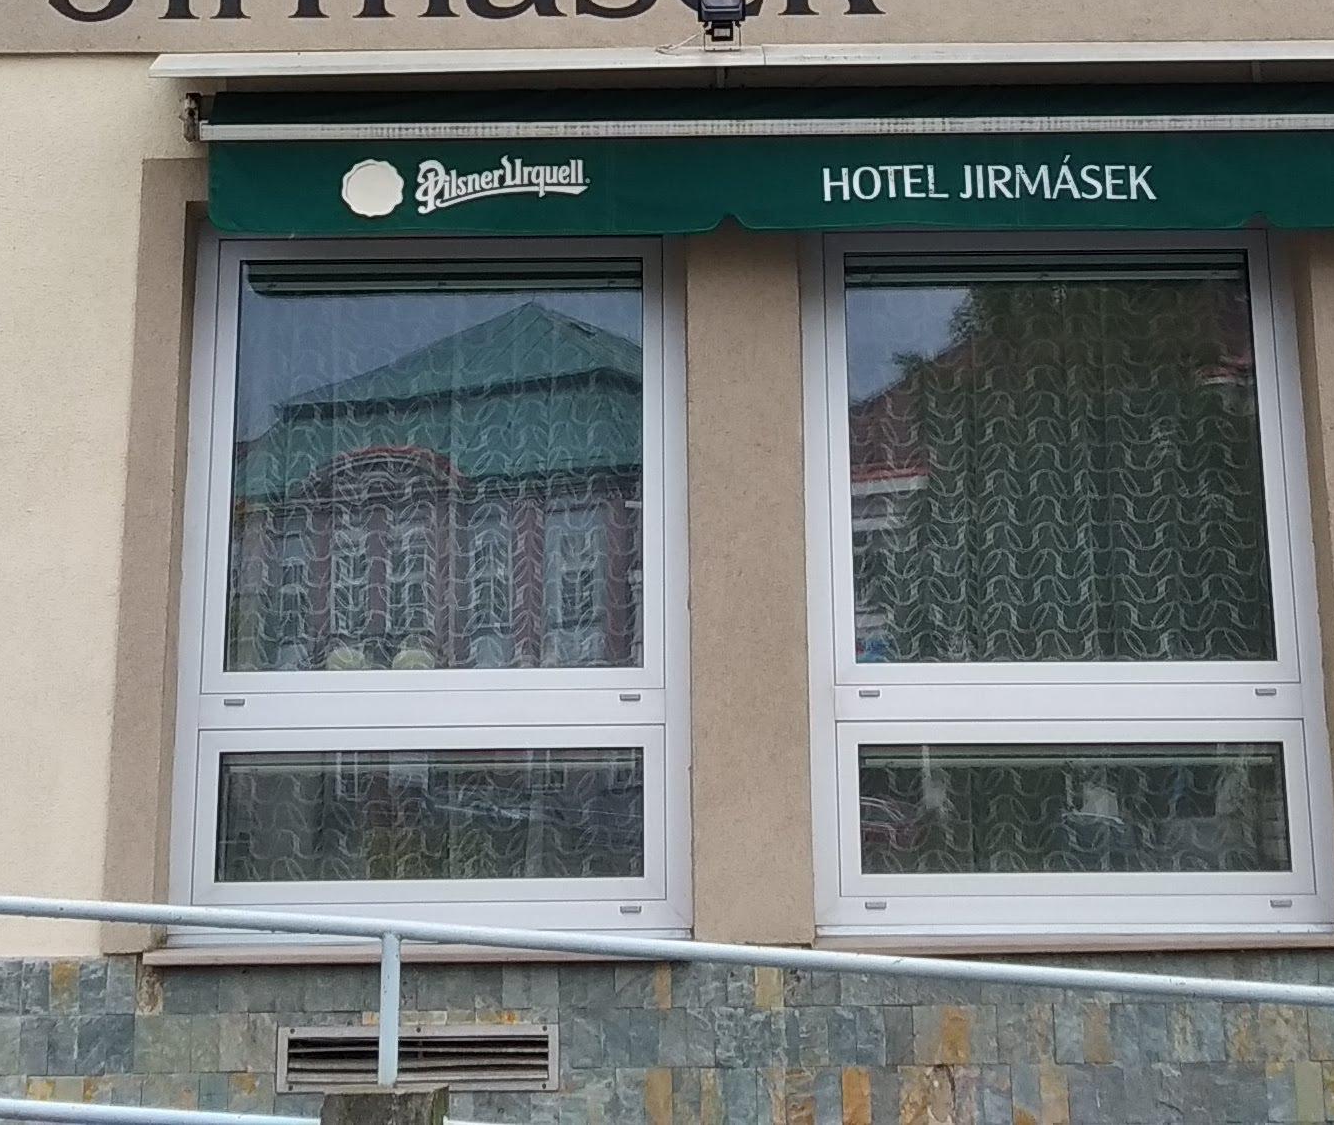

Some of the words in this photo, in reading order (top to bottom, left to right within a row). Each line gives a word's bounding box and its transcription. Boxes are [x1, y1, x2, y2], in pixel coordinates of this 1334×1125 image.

[415, 159, 506, 214] Pilsner
[501, 155, 585, 197] Urquell
[822, 164, 949, 201] HOTEL
[959, 155, 1157, 200] JIRMÁSEK
